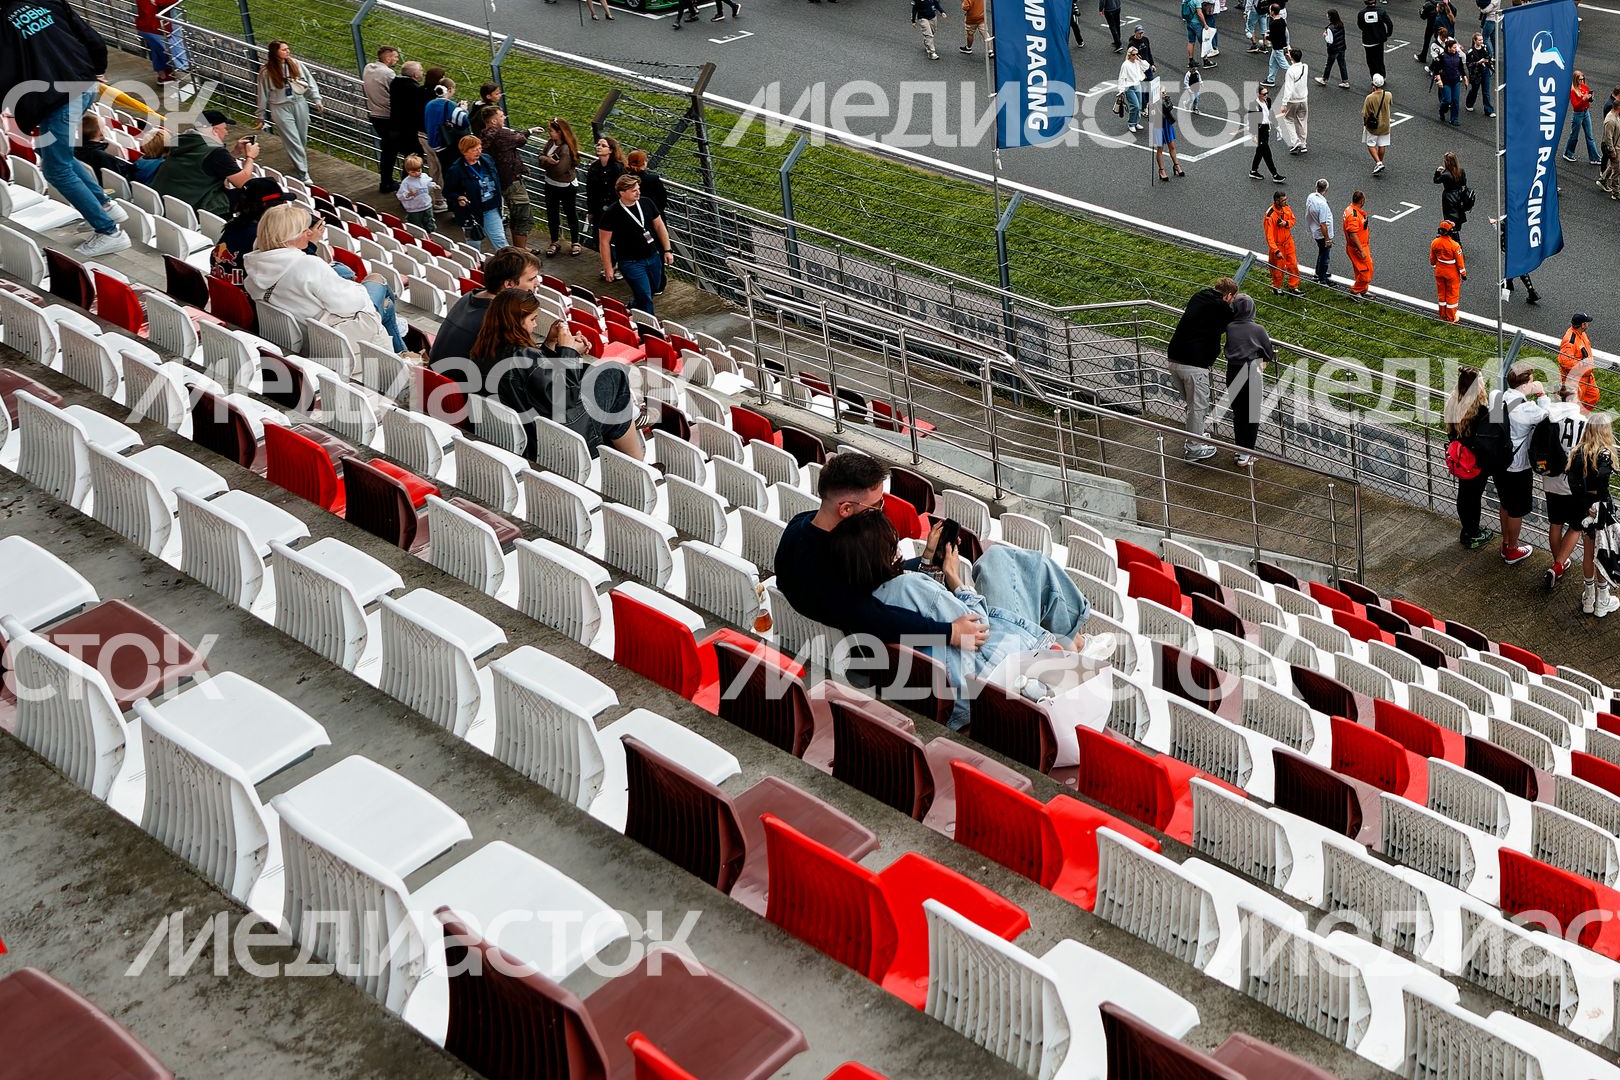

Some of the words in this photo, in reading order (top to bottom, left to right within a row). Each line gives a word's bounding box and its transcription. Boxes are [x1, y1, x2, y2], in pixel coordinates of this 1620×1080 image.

[1025, 33, 1049, 131] RACING
[1537, 76, 1557, 141] SMP
[1527, 145, 1553, 249] RACING
